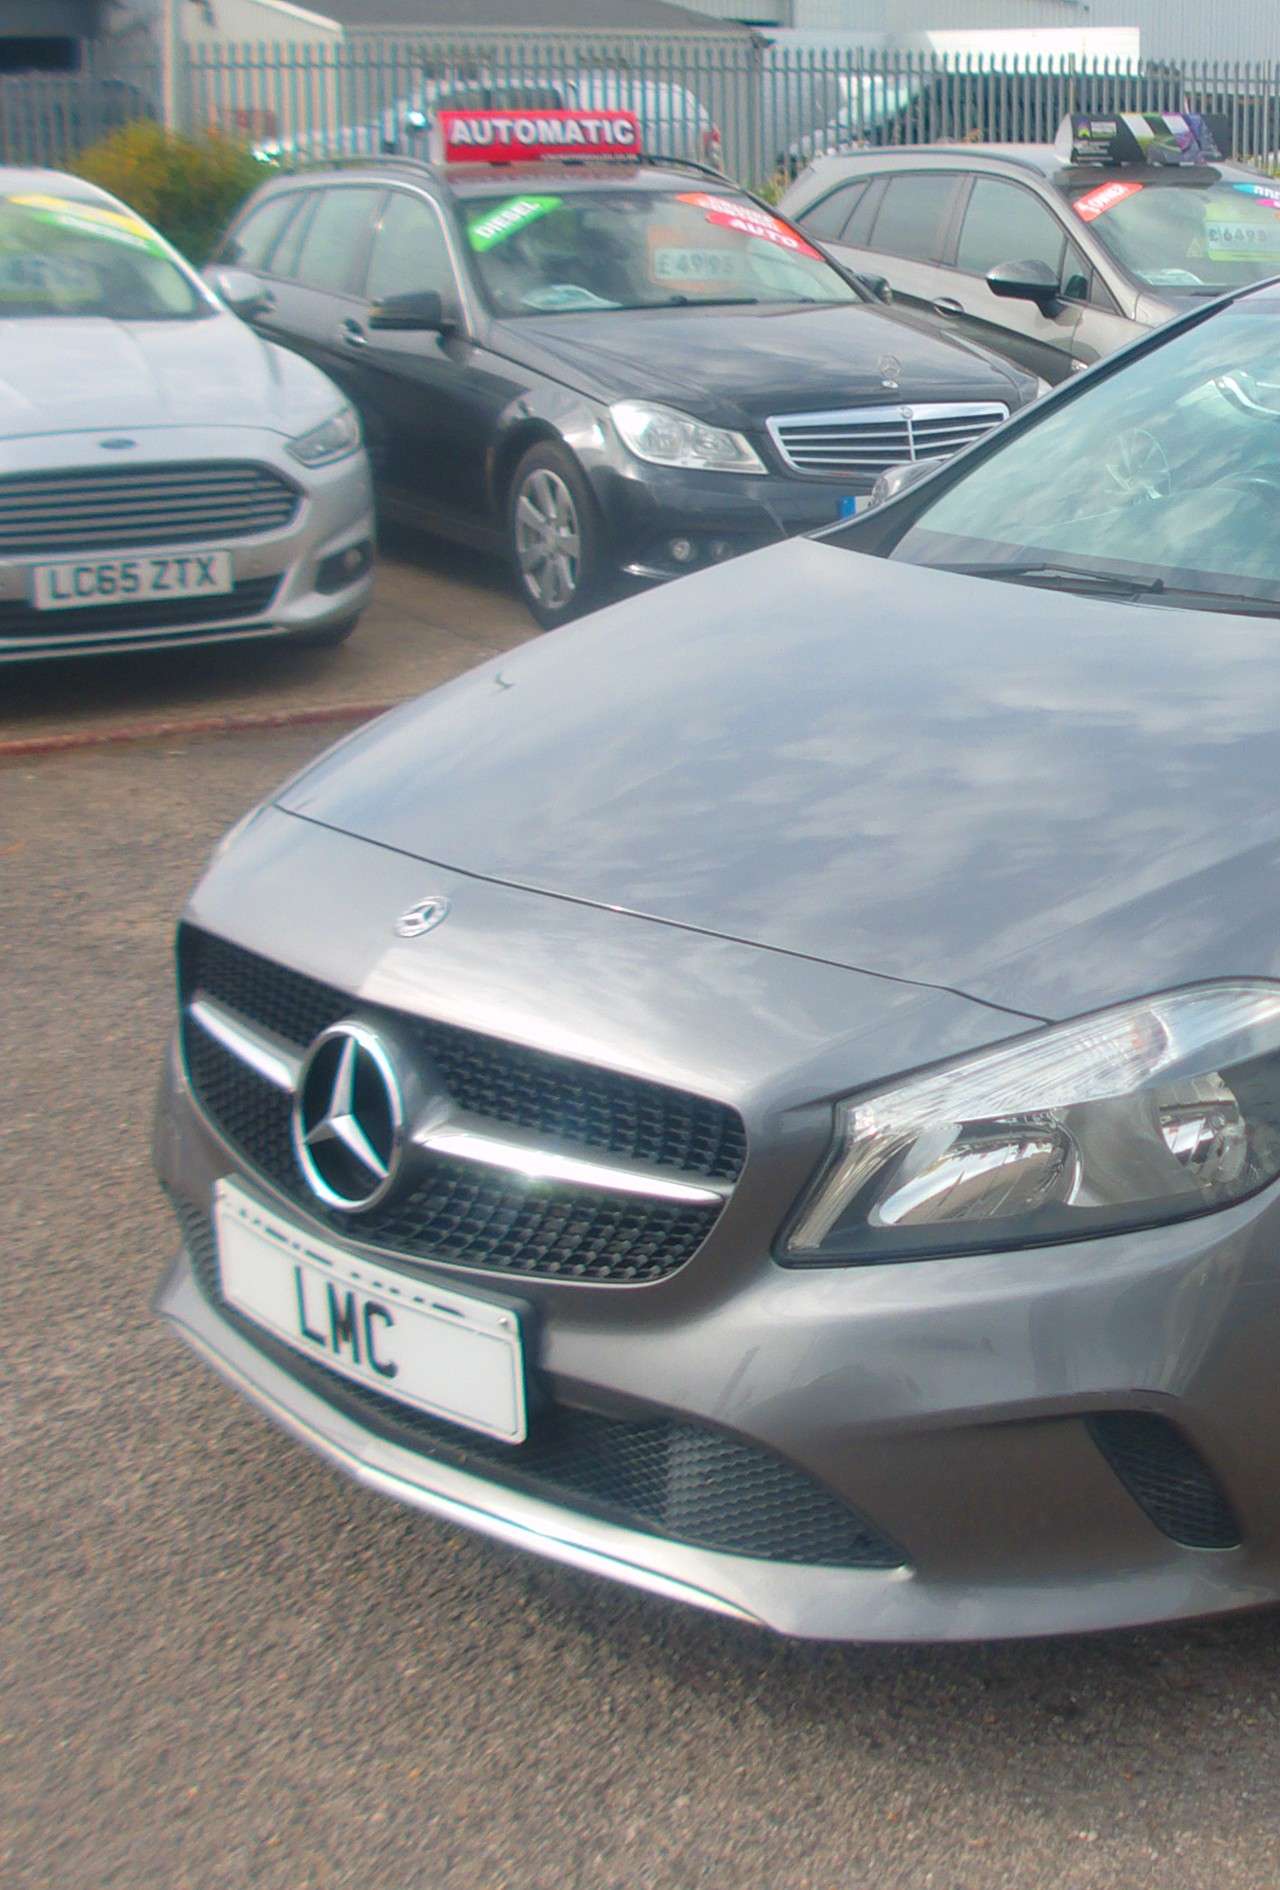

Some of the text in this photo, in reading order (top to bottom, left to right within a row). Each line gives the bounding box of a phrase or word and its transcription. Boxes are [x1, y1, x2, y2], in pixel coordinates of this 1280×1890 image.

[451, 118, 636, 146] AUTOMATIC
[475, 201, 540, 239] DIESEL
[729, 218, 799, 249] AUTO
[50, 555, 217, 600] LC65 ZTX
[295, 1265, 398, 1379] LMC
